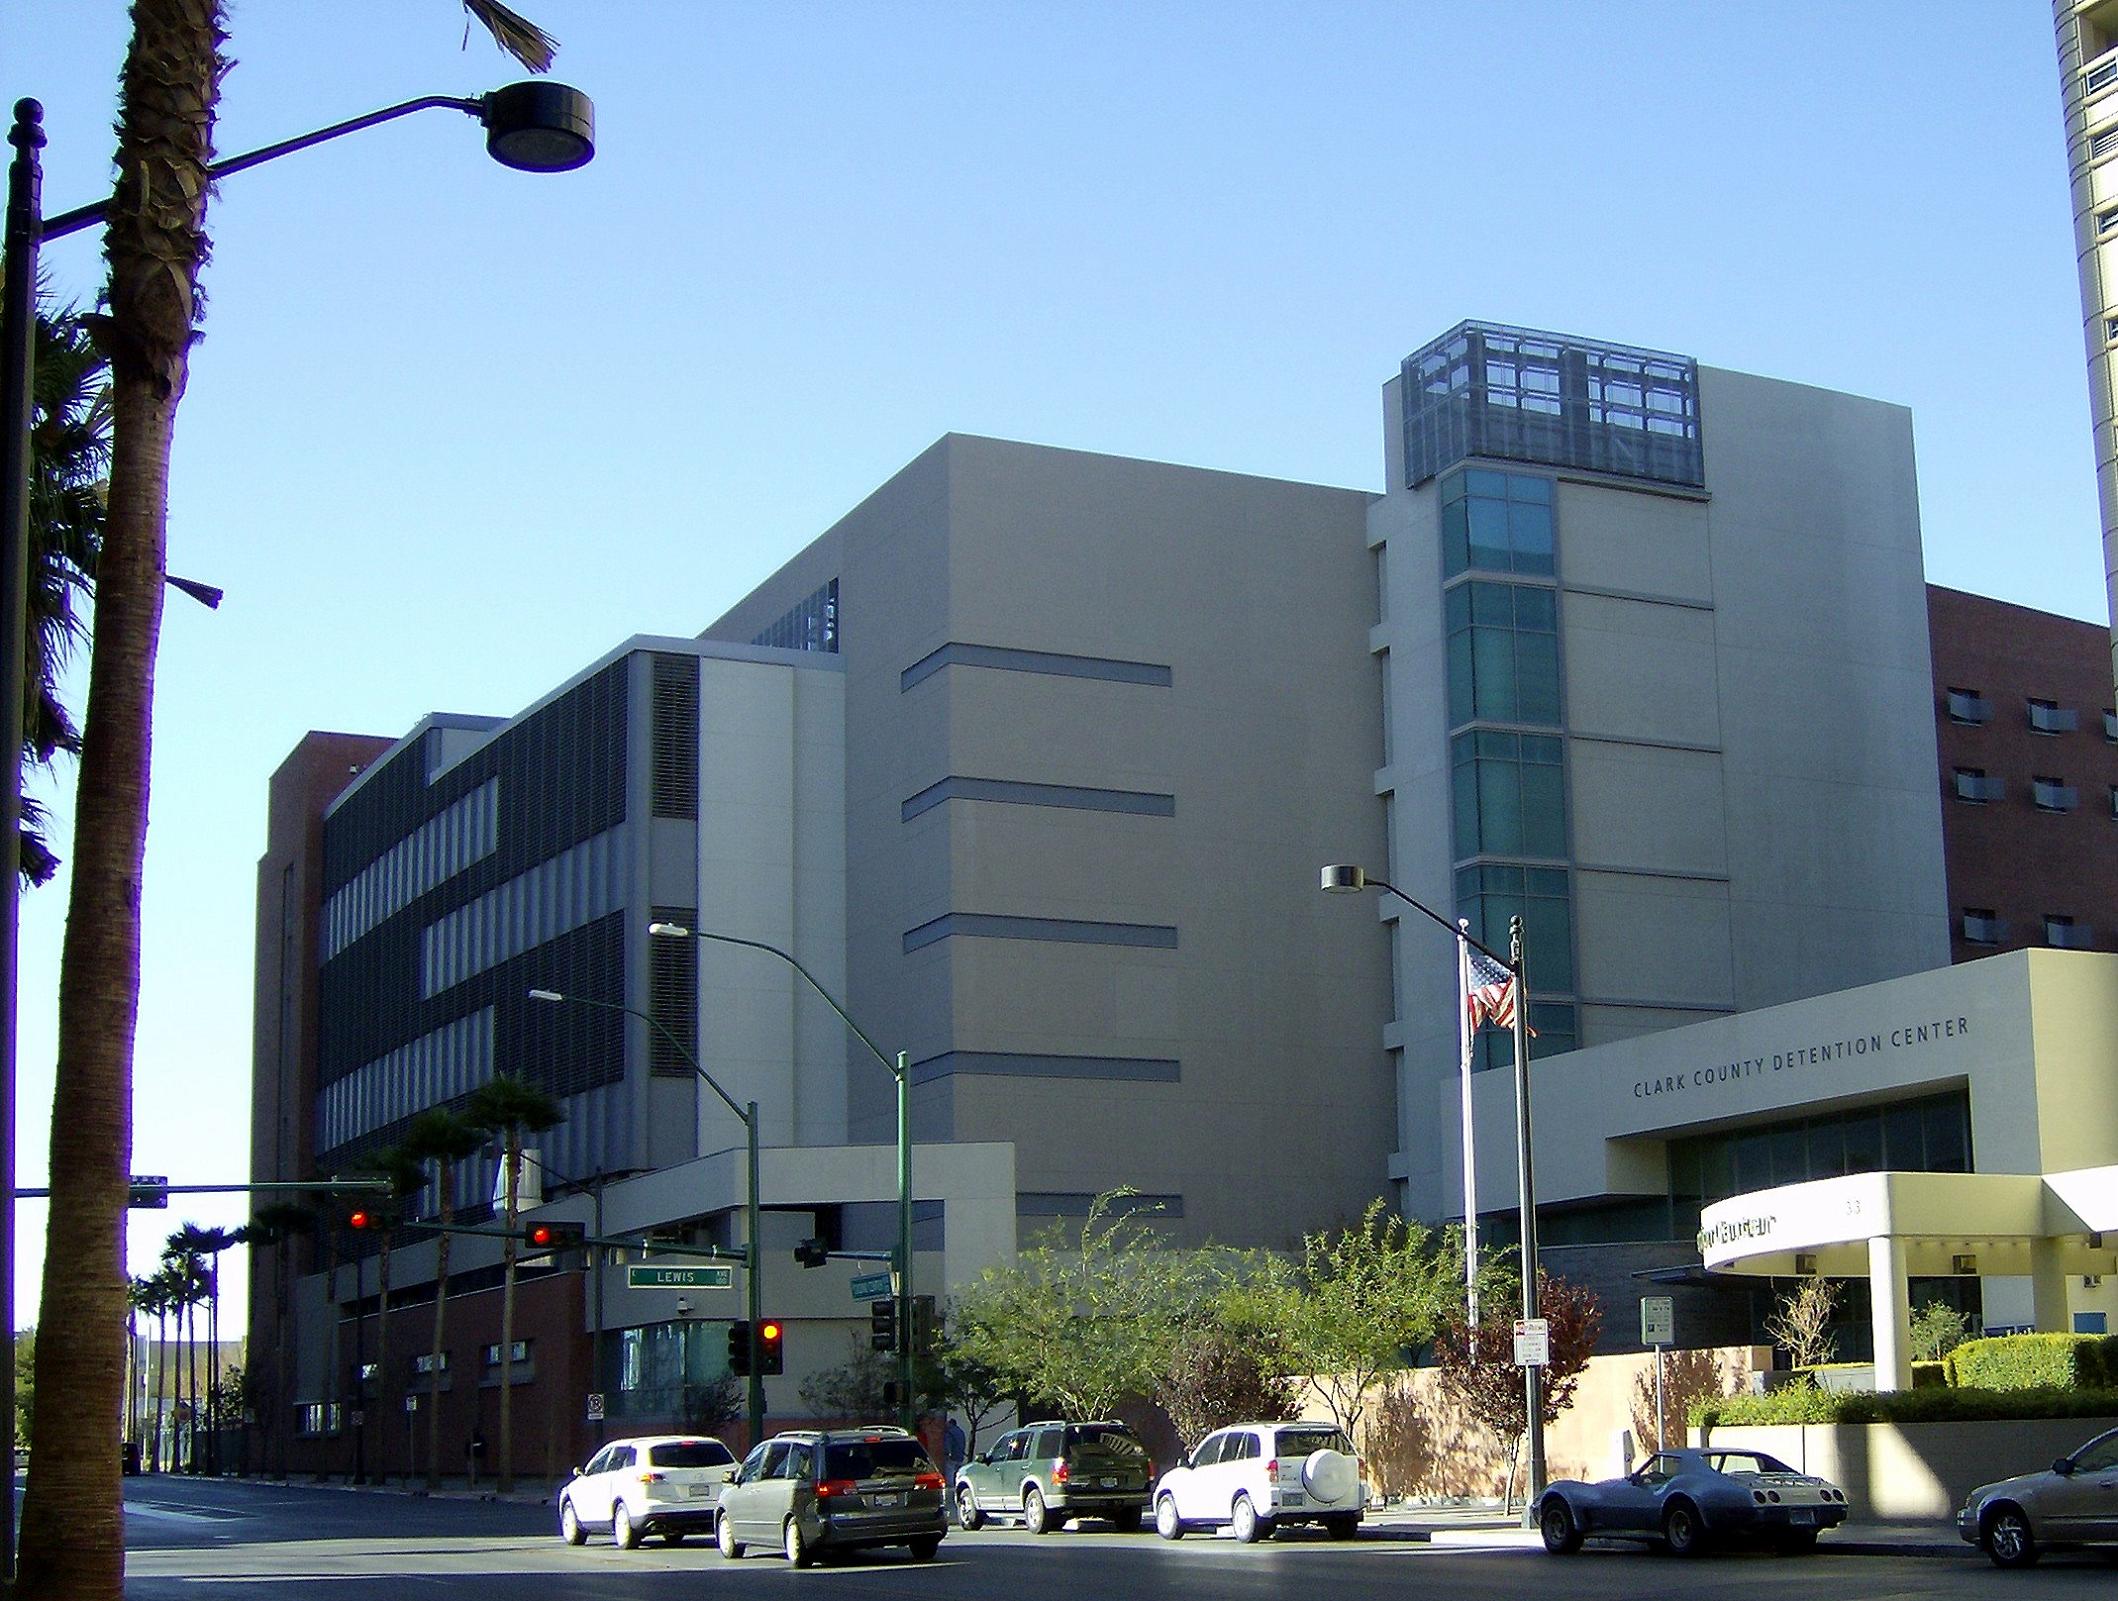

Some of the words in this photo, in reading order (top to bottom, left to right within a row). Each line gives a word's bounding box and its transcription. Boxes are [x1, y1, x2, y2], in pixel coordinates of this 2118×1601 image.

[1634, 1074, 1685, 1098] CLARK
[1693, 1058, 1764, 1086] COUNTY
[1773, 1035, 1881, 1071] DETENTION
[1891, 1017, 1969, 1047] CENTER
[656, 1271, 695, 1283] LEWIS
